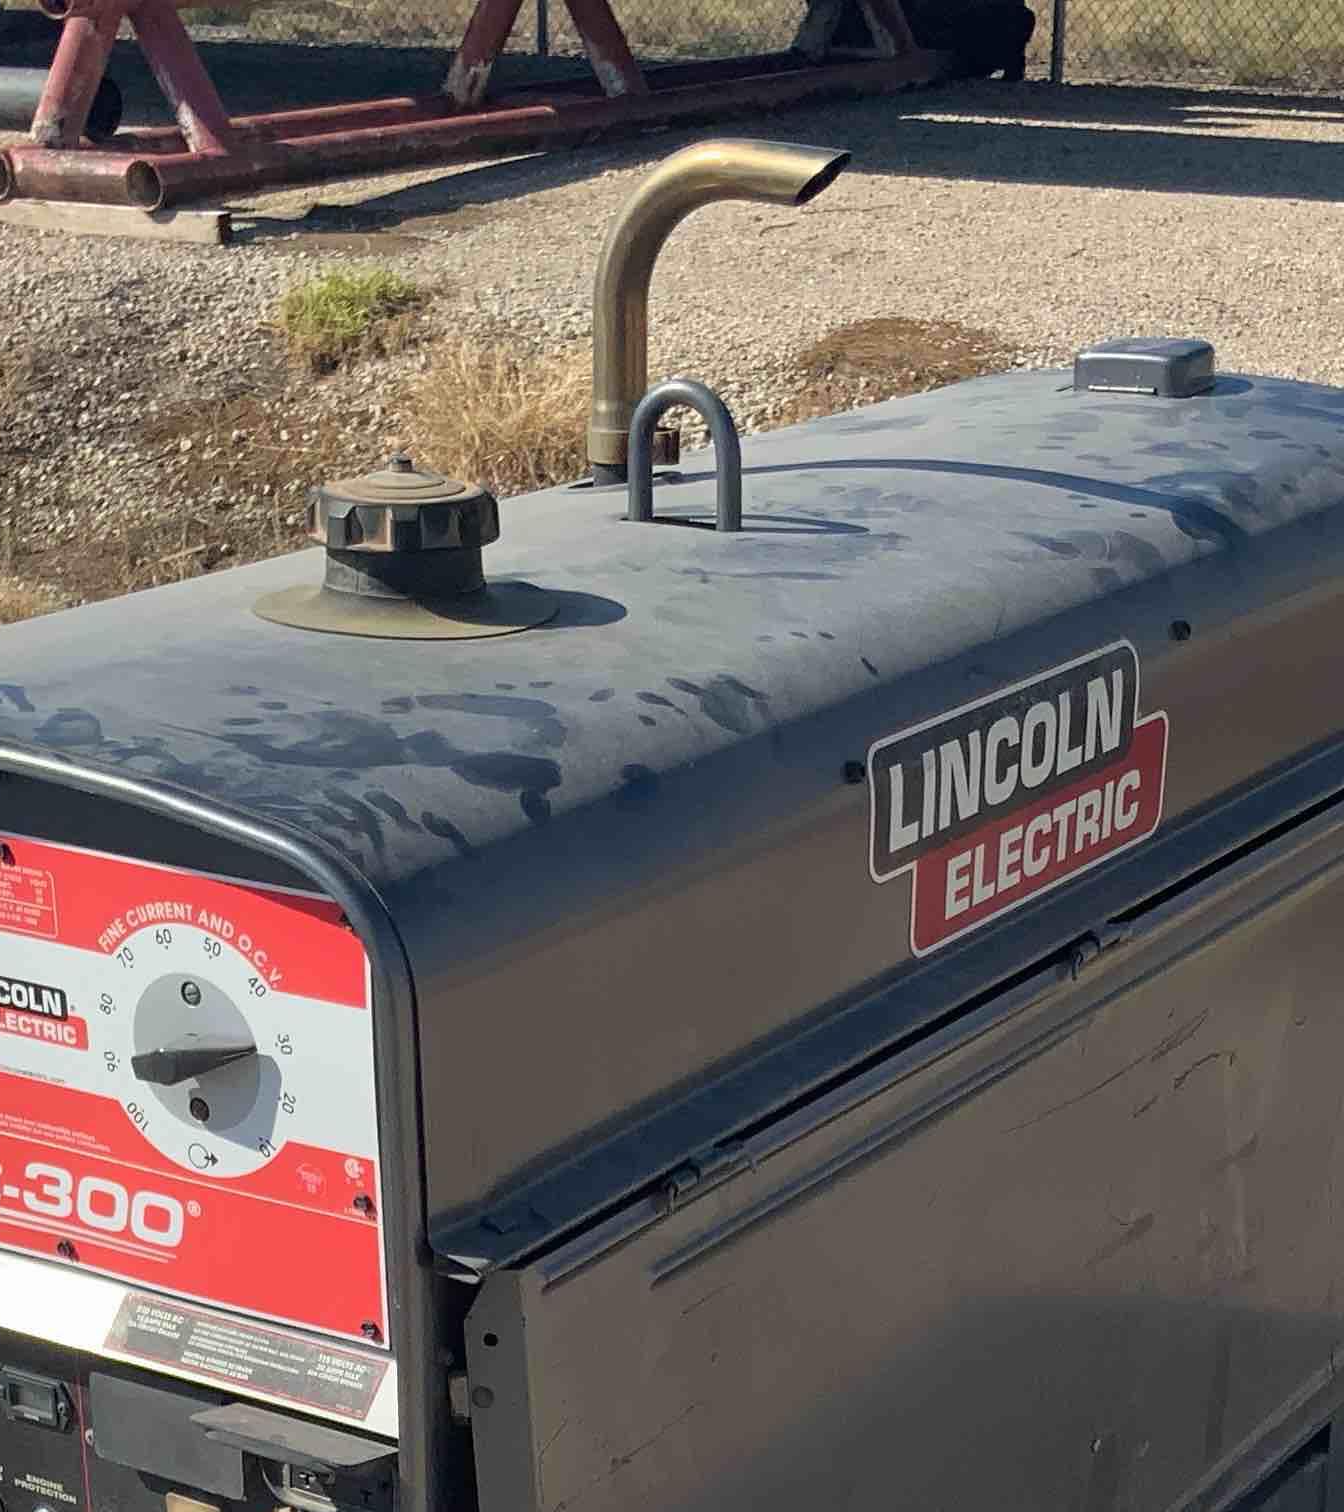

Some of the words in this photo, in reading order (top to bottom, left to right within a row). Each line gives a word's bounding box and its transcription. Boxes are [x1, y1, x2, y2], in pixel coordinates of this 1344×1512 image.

[889, 668, 1123, 854] LINCOLN
[944, 768, 1141, 921] ELECTRIC
[98, 917, 127, 951] FINE
[126, 901, 193, 928] CURRENT
[197, 909, 235, 939] AND
[155, 928, 172, 945] 60
[116, 946, 134, 969] 70
[203, 937, 222, 957] 50
[248, 977, 266, 998] 40
[99, 993, 113, 1015] 80
[277, 1033, 293, 1056] 30
[104, 1051, 117, 1073] 90
[282, 1091, 296, 1115] 20
[126, 1102, 151, 1131] 100
[258, 1139, 277, 1159] 10
[14, 1478, 77, 1505] PROTECTION
[25, 1474, 64, 1491] ENGINE
